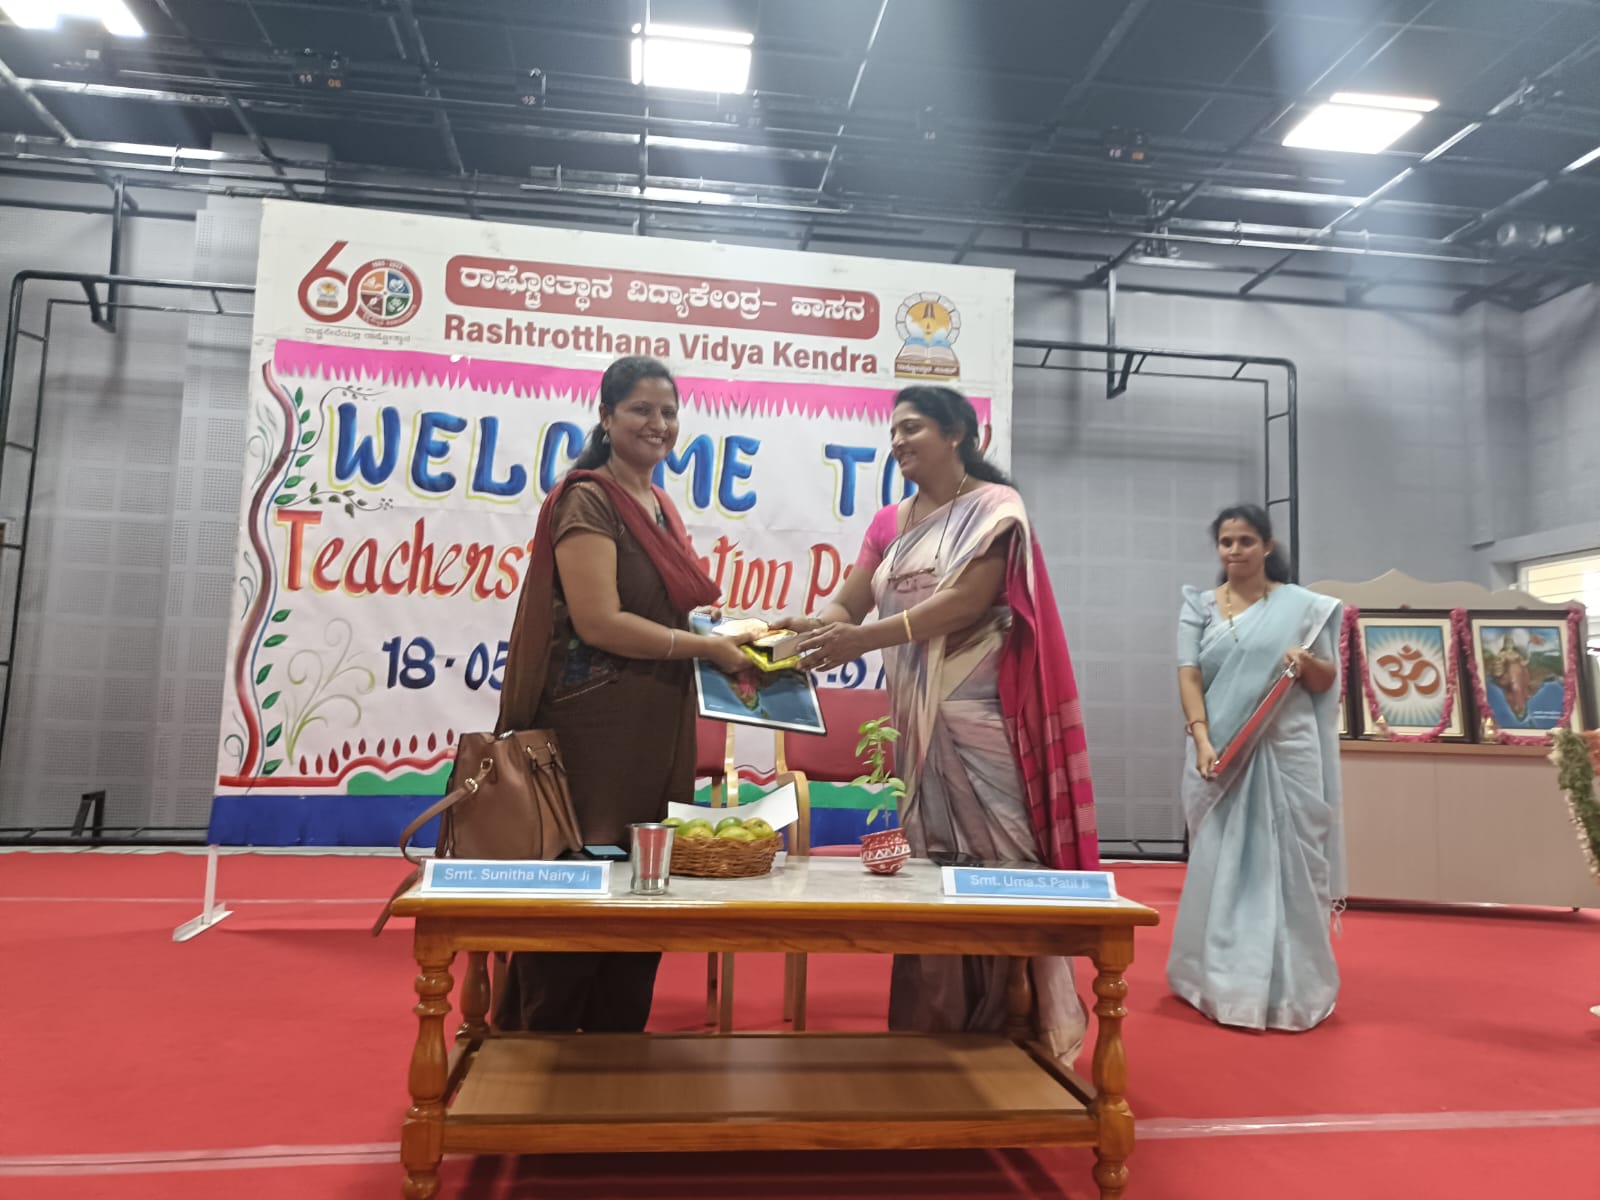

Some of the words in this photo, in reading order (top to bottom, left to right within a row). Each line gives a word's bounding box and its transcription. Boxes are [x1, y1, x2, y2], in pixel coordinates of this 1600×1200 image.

[791, 295, 866, 321] ಹಾಸನ
[444, 313, 671, 358] Rashtrotthana
[679, 333, 764, 370] Vidya
[772, 341, 878, 374] Kendra
[334, 402, 761, 512] WELCME
[444, 867, 476, 881] Smt.
[481, 868, 535, 882] Sunitha
[538, 869, 575, 884] Nairy
[578, 870, 590, 882] Ji
[970, 875, 1000, 886] Smt.
